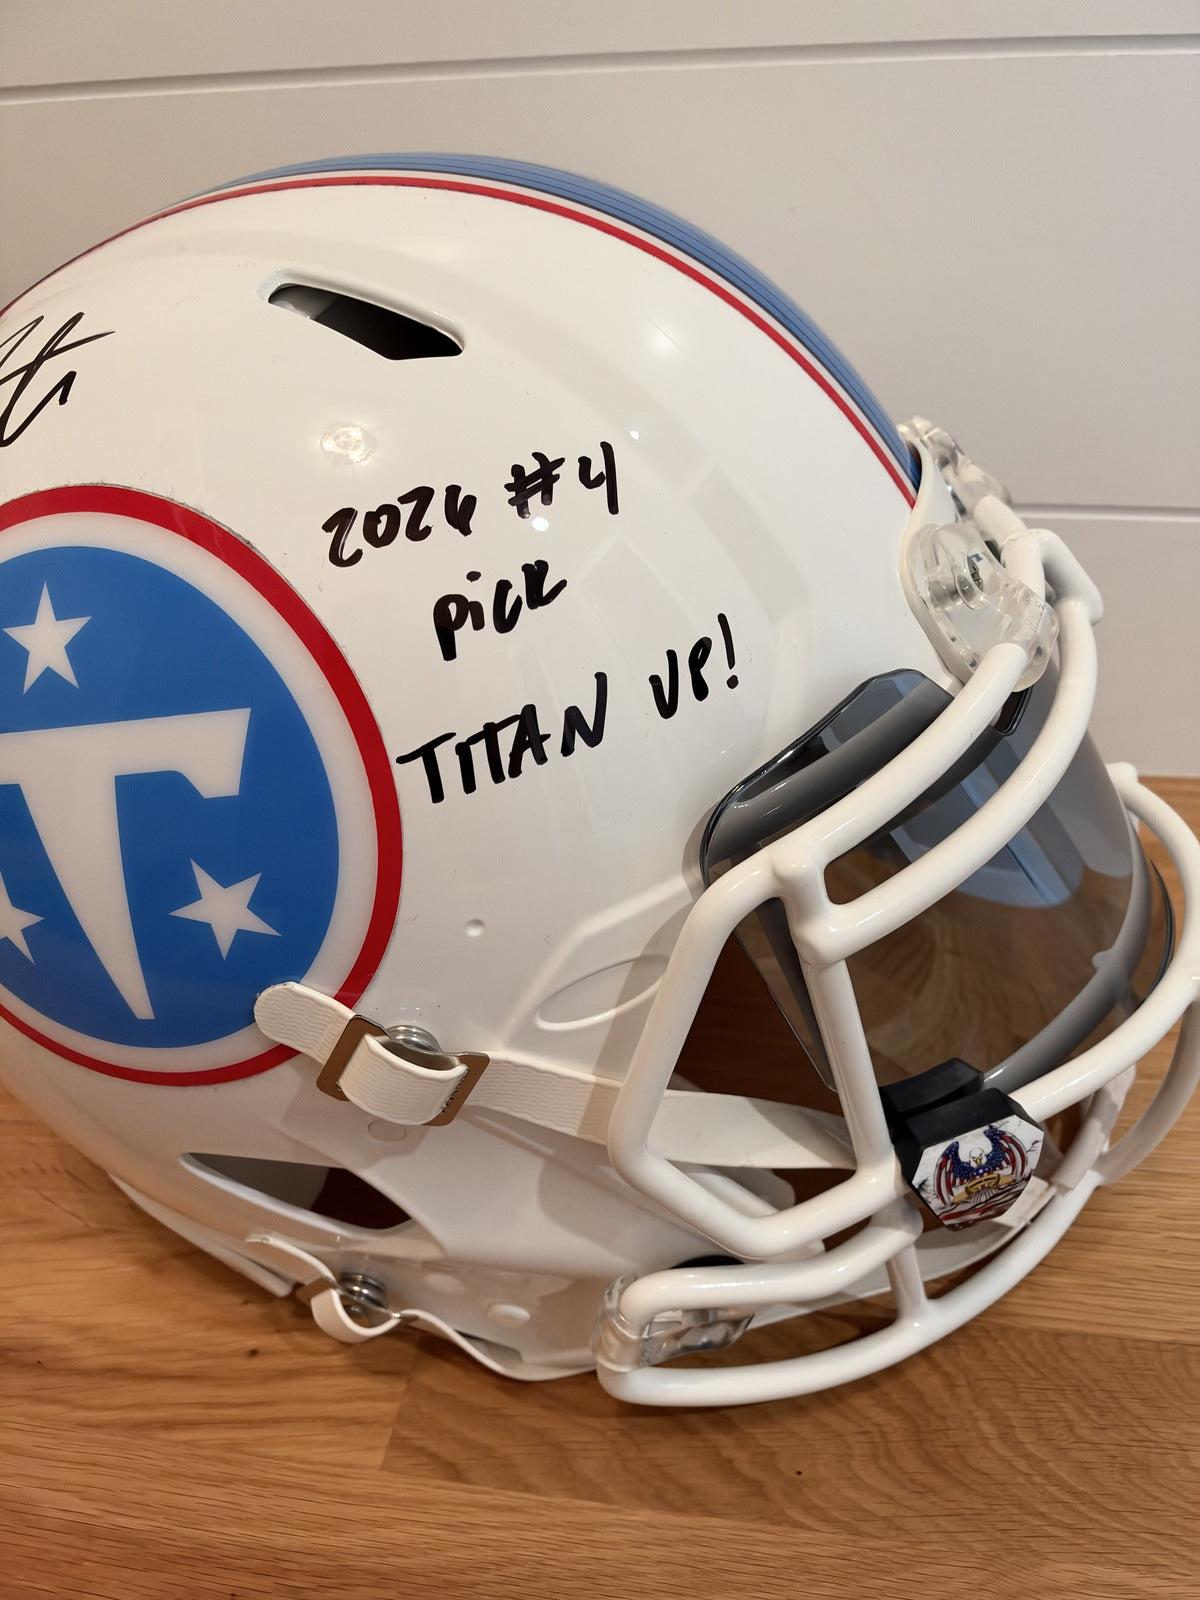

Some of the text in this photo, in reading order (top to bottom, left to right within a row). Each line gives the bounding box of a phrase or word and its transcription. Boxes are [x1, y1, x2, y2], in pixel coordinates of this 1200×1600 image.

[503, 441, 620, 519] #4
[395, 612, 739, 805] TITAN UP!
